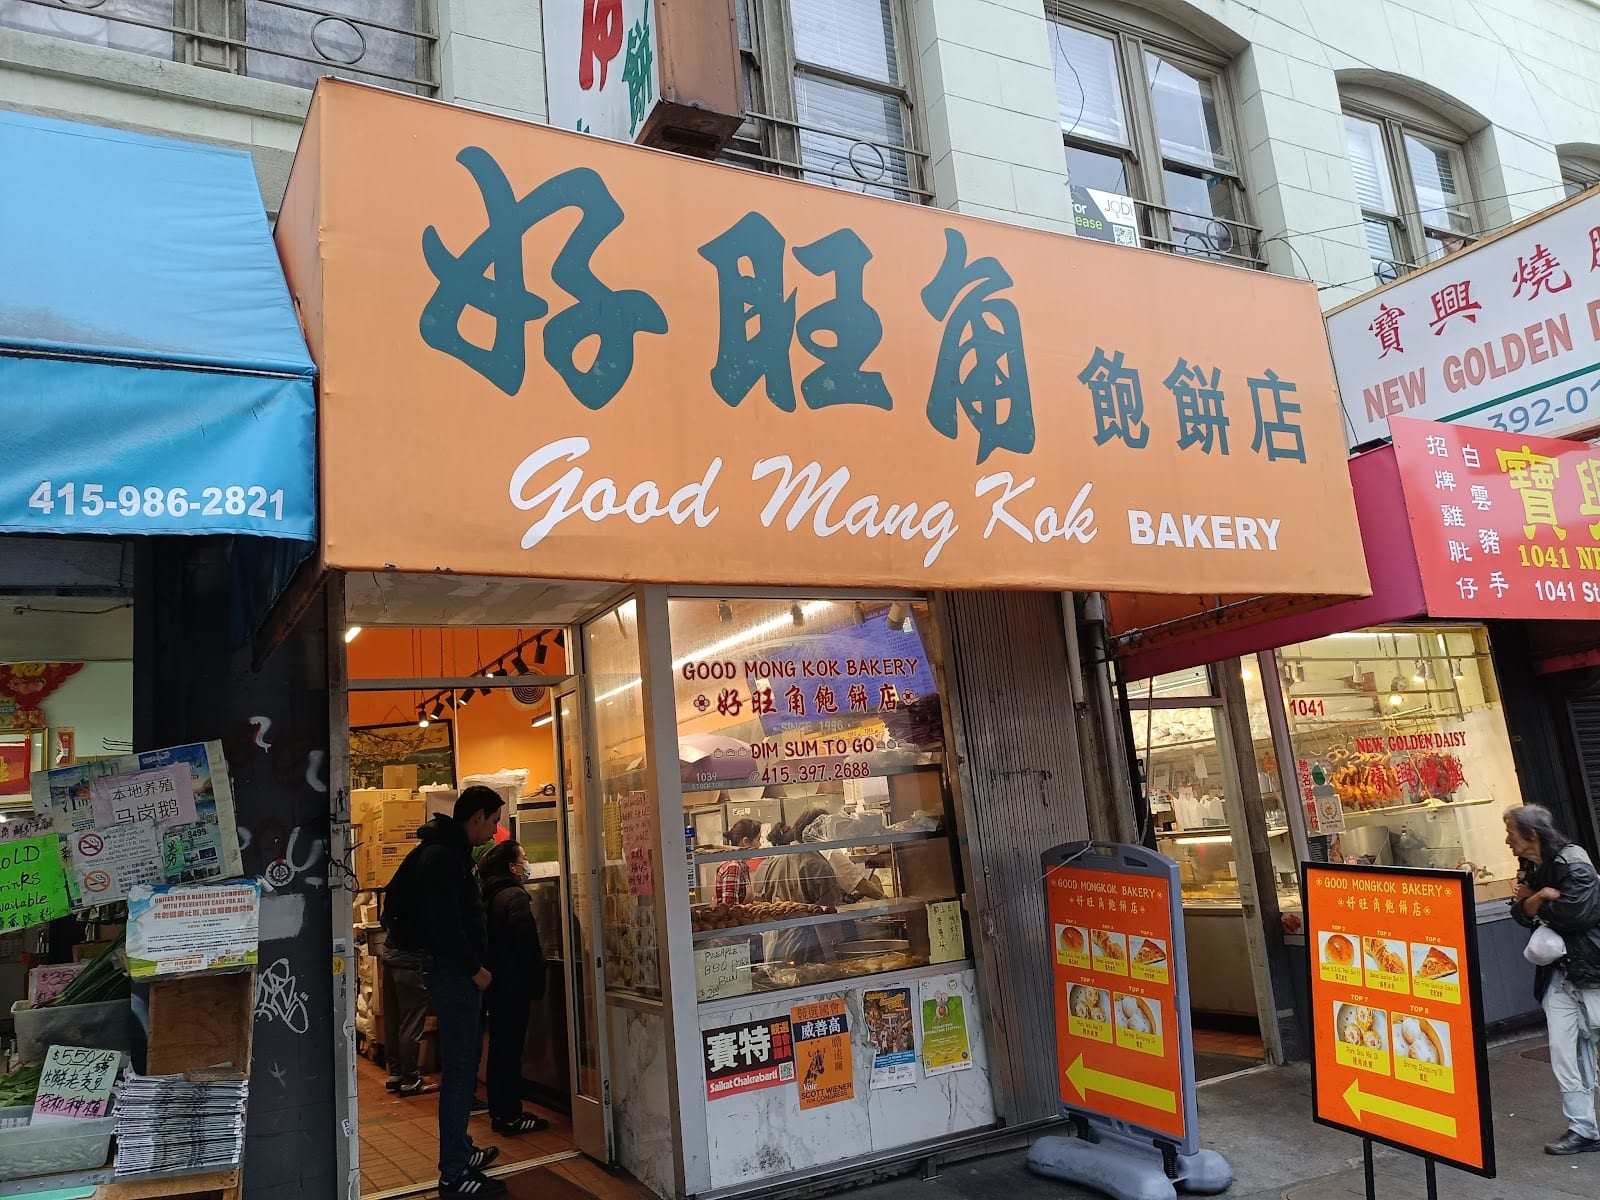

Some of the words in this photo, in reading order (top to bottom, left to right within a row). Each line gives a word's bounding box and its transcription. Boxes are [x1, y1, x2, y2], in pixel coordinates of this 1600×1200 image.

[1073, 203, 1087, 214] or
[1075, 216, 1103, 230] ease
[1362, 367, 1427, 423] NEW
[1442, 312, 1574, 394] GOLDEN
[1488, 378, 1600, 433] 392-0
[28, 480, 285, 521] 415-986-2821
[508, 436, 724, 550] Good
[975, 470, 1099, 545] Kok
[1128, 509, 1281, 552] BAKERY
[1518, 544, 1570, 569] 1041
[1535, 580, 1576, 602] 1041
[683, 660, 737, 681] GOOD
[745, 660, 797, 679] MONG
[802, 658, 842, 678] KOK
[846, 657, 919, 678] BAKERY
[717, 683, 899, 717] 好旺角飽餅店
[1289, 699, 1325, 716] 1041
[780, 721, 813, 733] SINCE
[819, 719, 844, 732] 1996
[750, 742, 779, 760] DIM
[784, 740, 819, 758] SUM
[823, 739, 847, 756] TO
[852, 737, 874, 754] GO
[1355, 737, 1383, 753] NEW
[1388, 733, 1433, 751] GOLDEN
[1434, 731, 1466, 748] DAISY
[696, 772, 718, 782] 1039
[761, 762, 870, 784] 415.397.2688
[112, 778, 175, 802] 本地养殖
[115, 799, 179, 825] 马岗鹅
[1057, 878, 1078, 889] GOOD
[1081, 881, 1118, 894] MONGKOK
[1121, 885, 1155, 899] BAKERY
[1324, 877, 1348, 890] GOOD
[1352, 879, 1396, 893] MONGKOK
[1402, 882, 1443, 898] BAKERY
[1350, 993, 1364, 1001] TOP
[1409, 1004, 1423, 1013] TOP
[707, 1024, 771, 1073] 賽特
[709, 1079, 733, 1093] Saikat
[733, 1070, 778, 1088] Chakrabarti
[800, 1088, 825, 1100] SCOTT
[826, 1082, 853, 1094] WIENER
